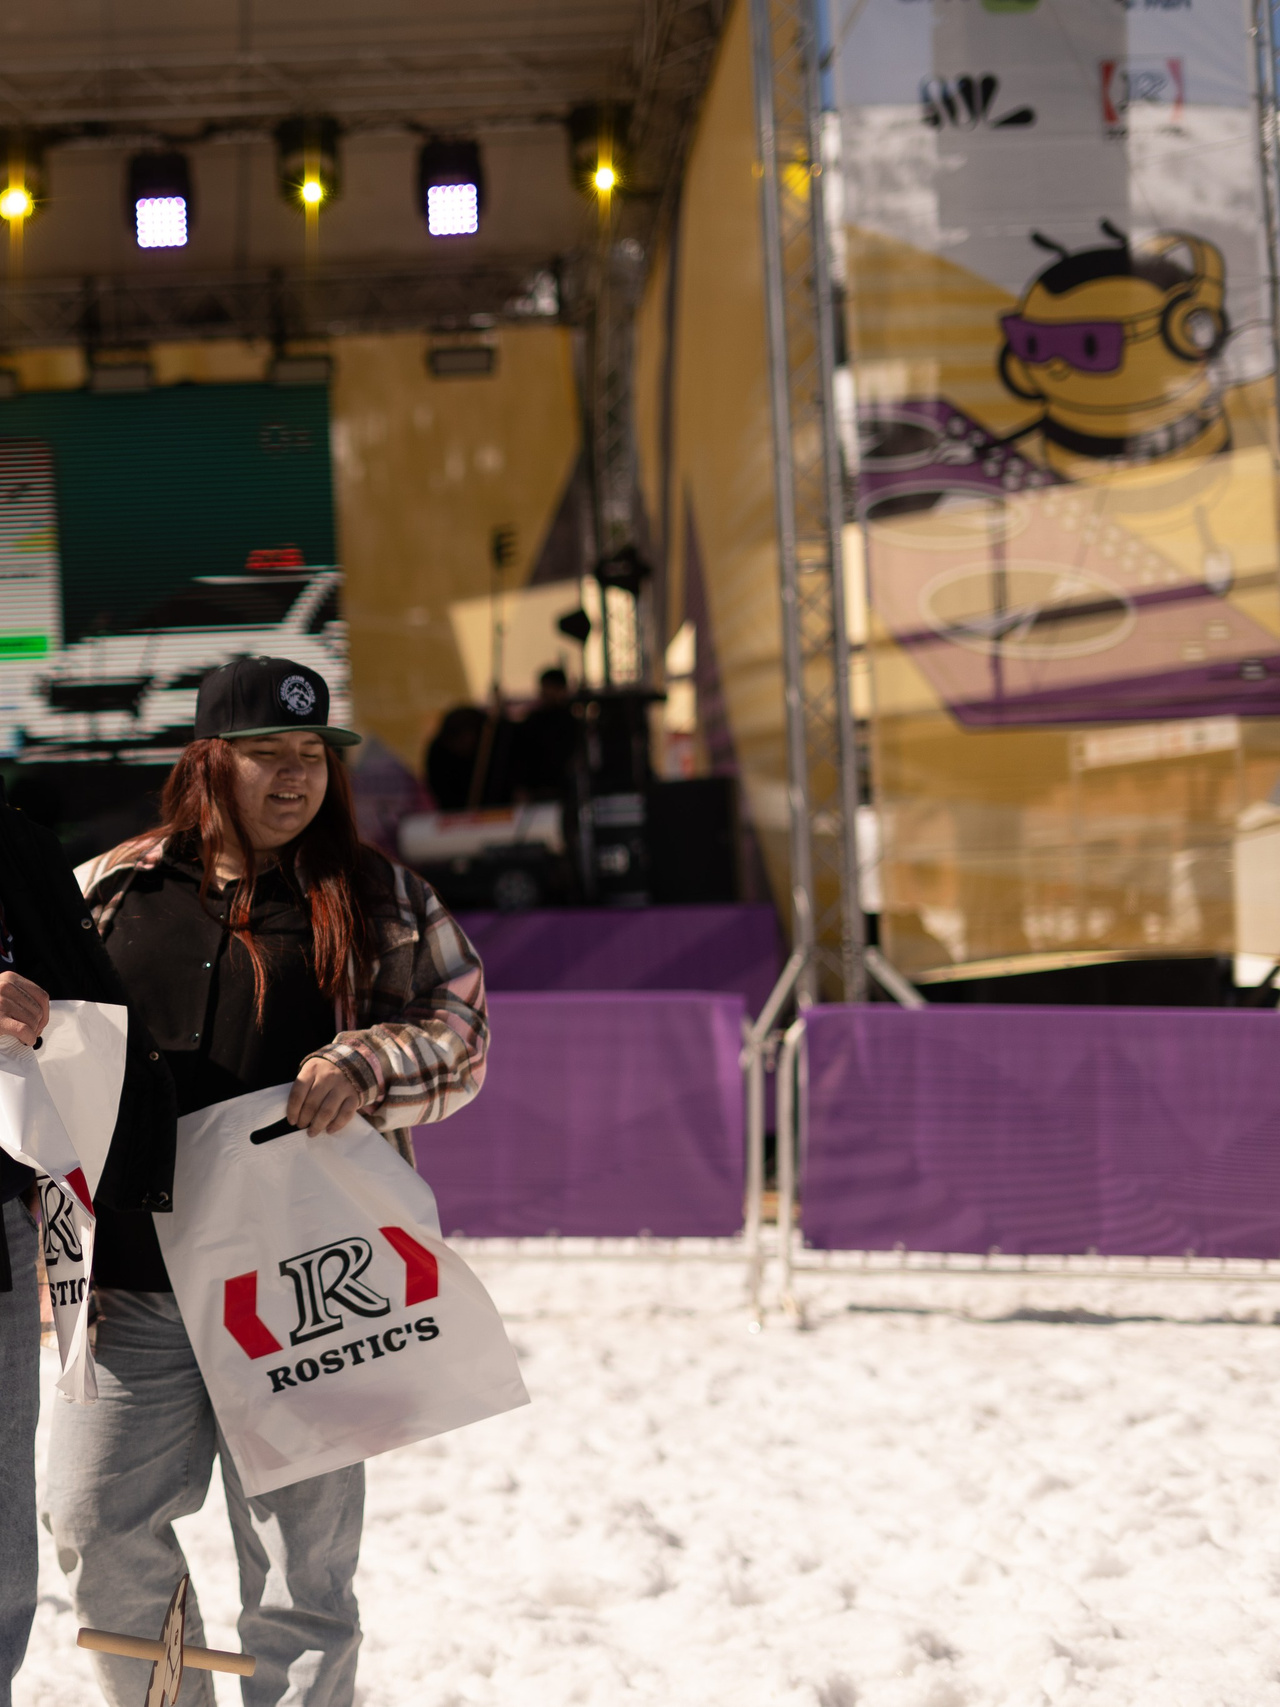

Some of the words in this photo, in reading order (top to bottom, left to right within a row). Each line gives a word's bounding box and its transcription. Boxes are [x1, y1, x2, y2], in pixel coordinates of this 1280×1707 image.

[49, 1277, 88, 1308] STIC
[279, 1236, 391, 1347] R
[266, 1316, 441, 1393] ROSTIC'S
